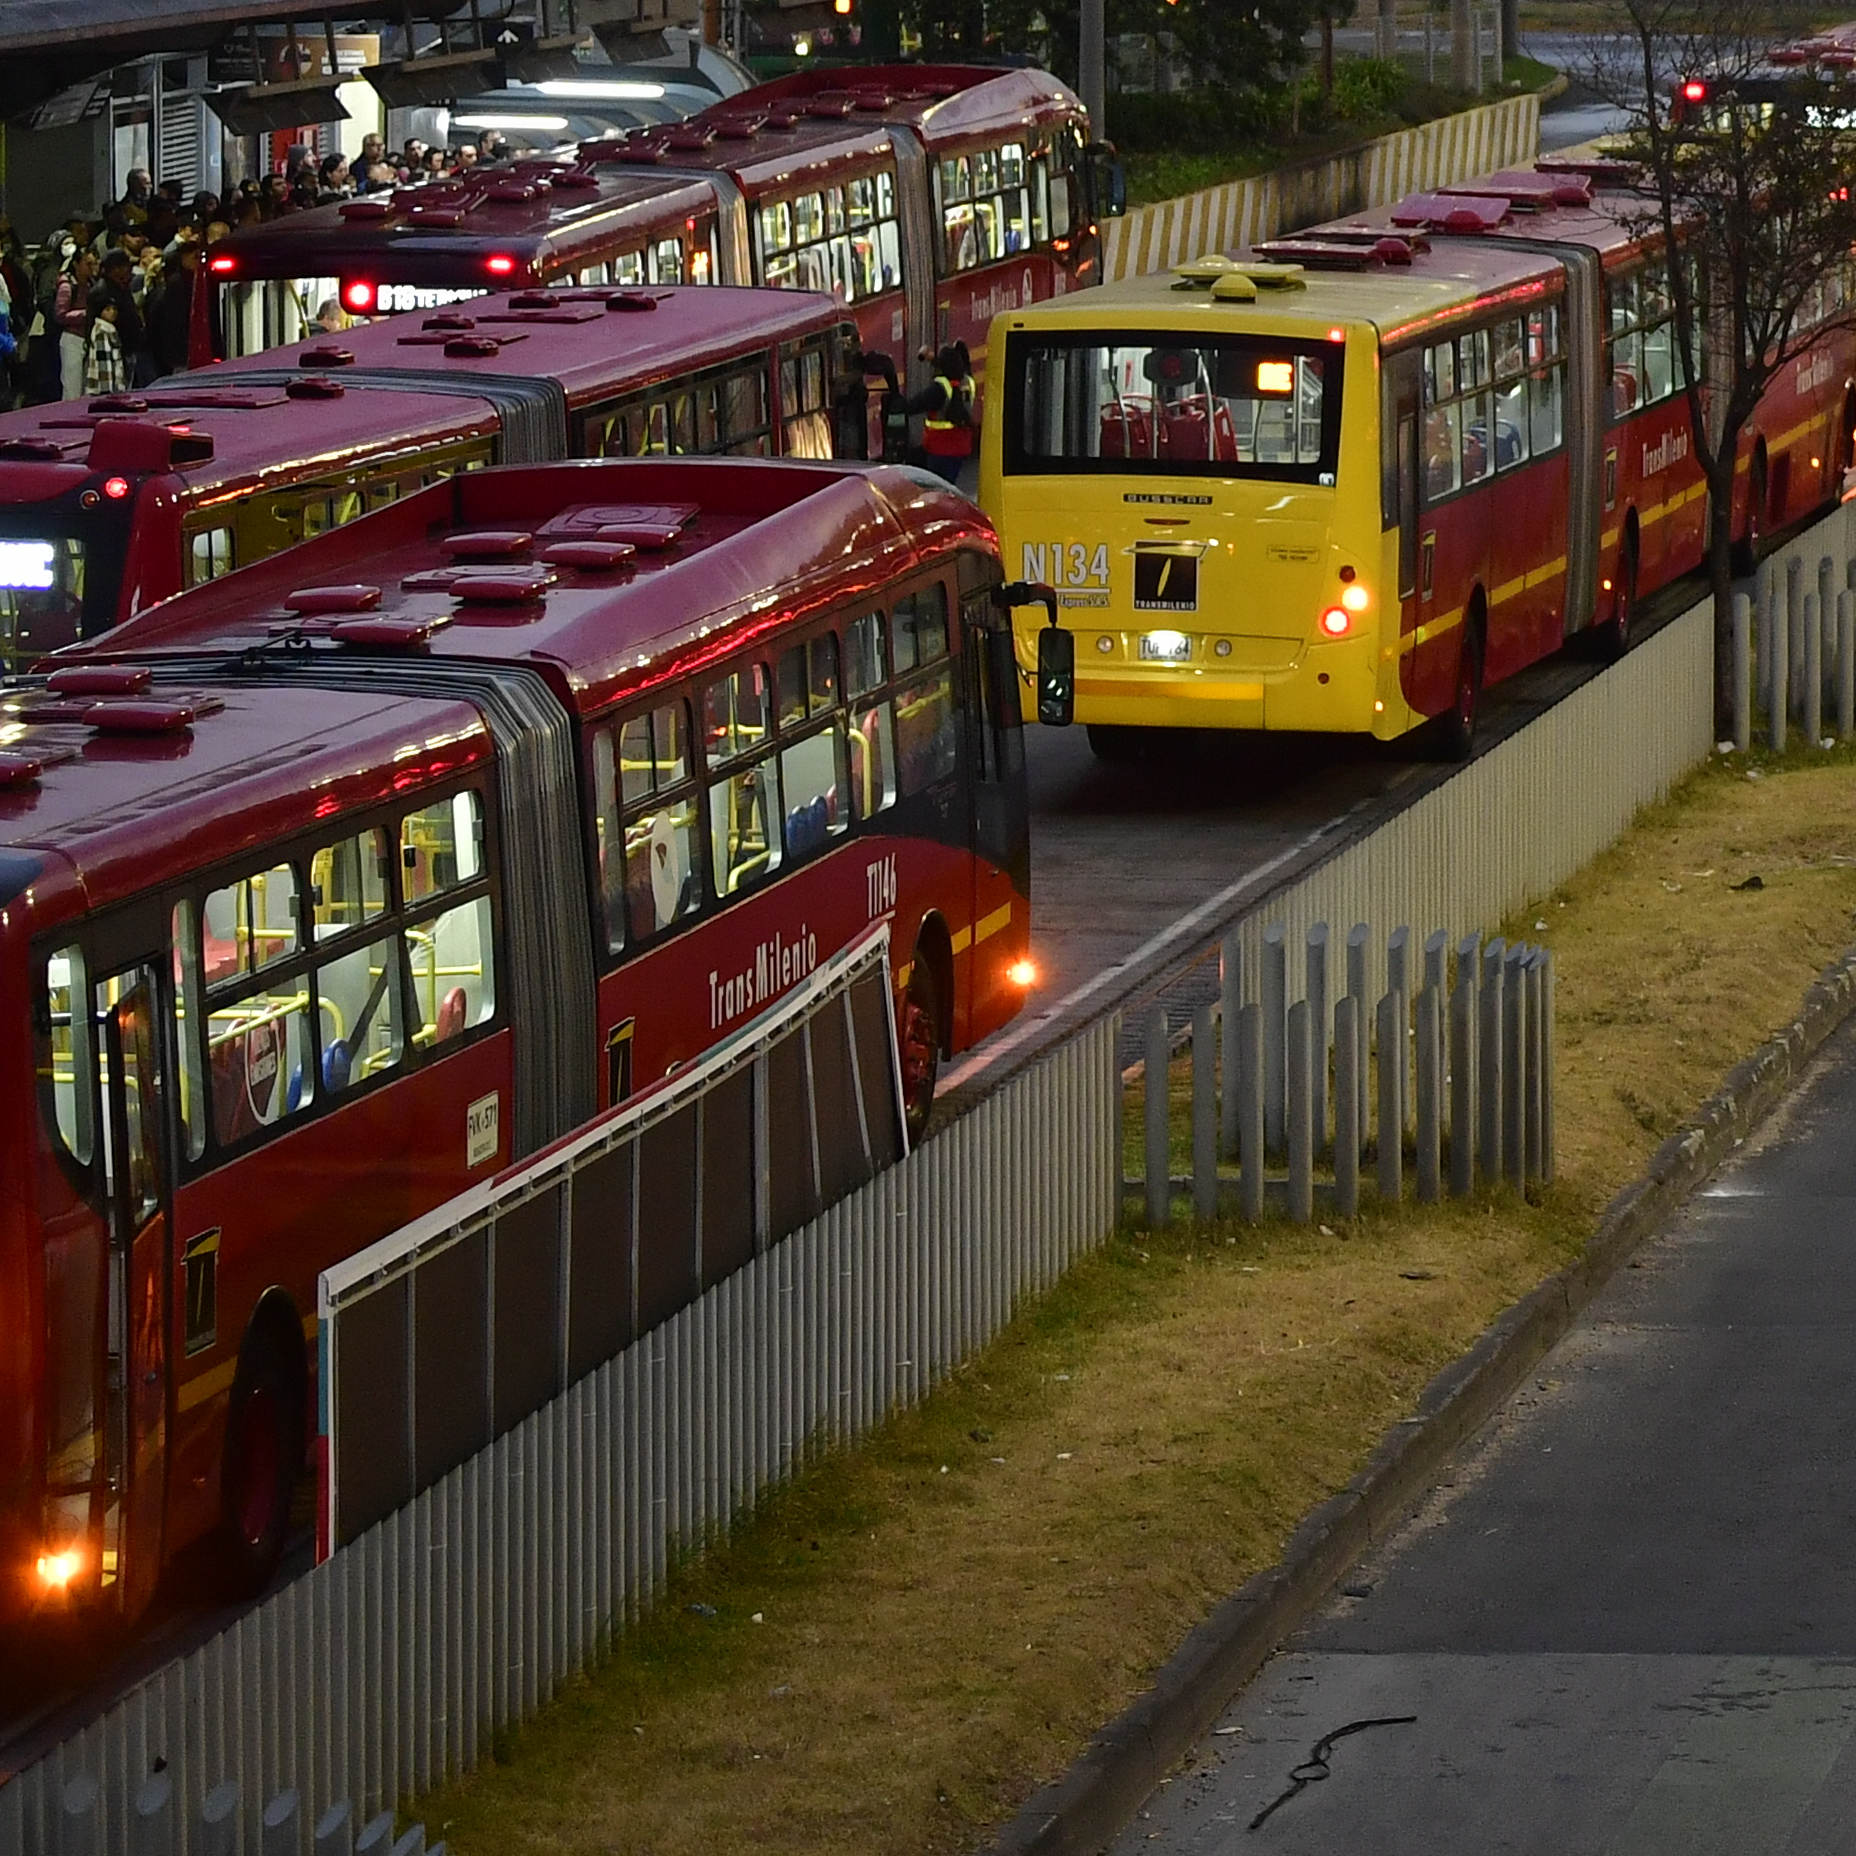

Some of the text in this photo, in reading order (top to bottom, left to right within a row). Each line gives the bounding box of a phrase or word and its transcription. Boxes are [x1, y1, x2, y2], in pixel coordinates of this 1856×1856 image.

[1642, 426, 1688, 478] TransMilenio
[1023, 542, 1109, 585] N134
[1135, 599, 1195, 611] TRANSMILENIO
[709, 923, 817, 1030] TransMilenio
